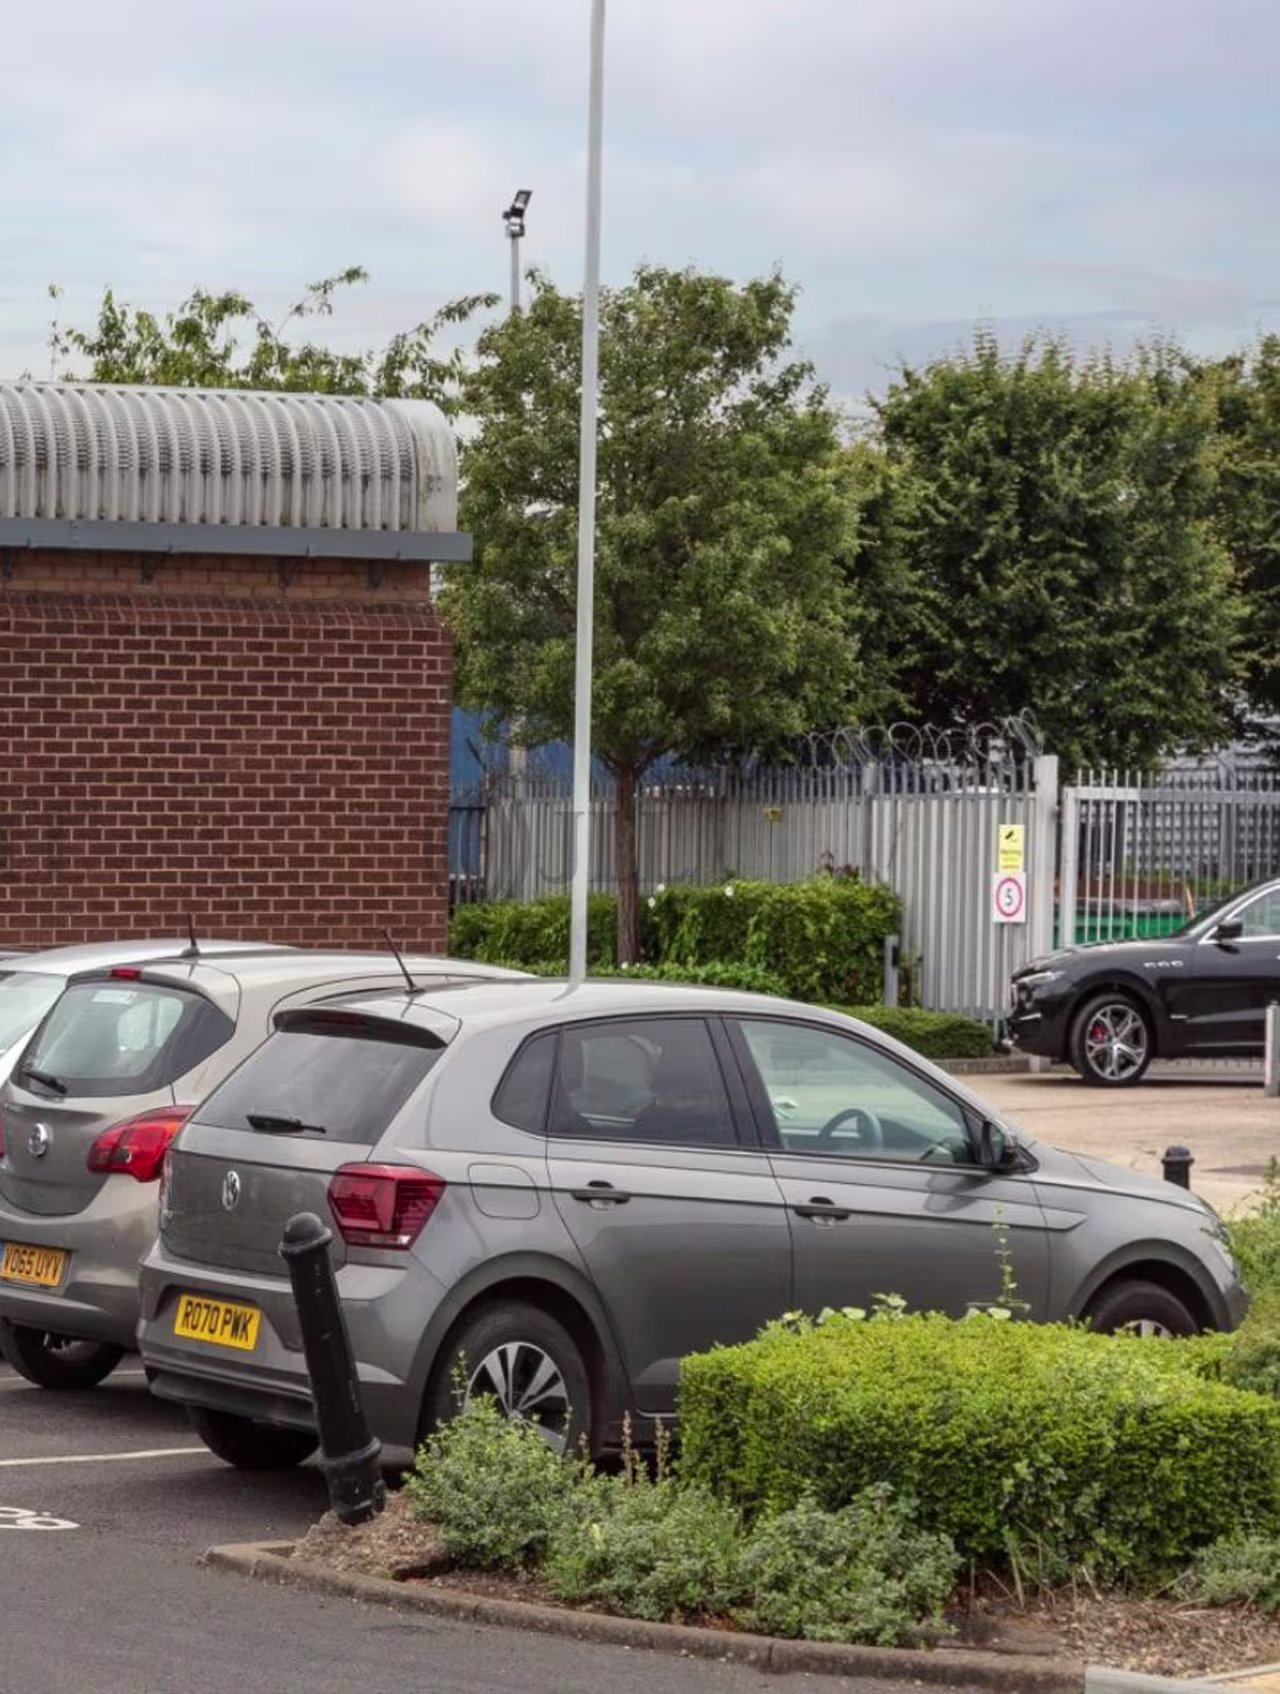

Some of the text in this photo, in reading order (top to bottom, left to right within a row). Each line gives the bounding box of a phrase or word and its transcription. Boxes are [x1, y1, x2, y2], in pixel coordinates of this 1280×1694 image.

[1004, 887, 1013, 907] 5
[181, 1299, 254, 1344] RO70 PWK
